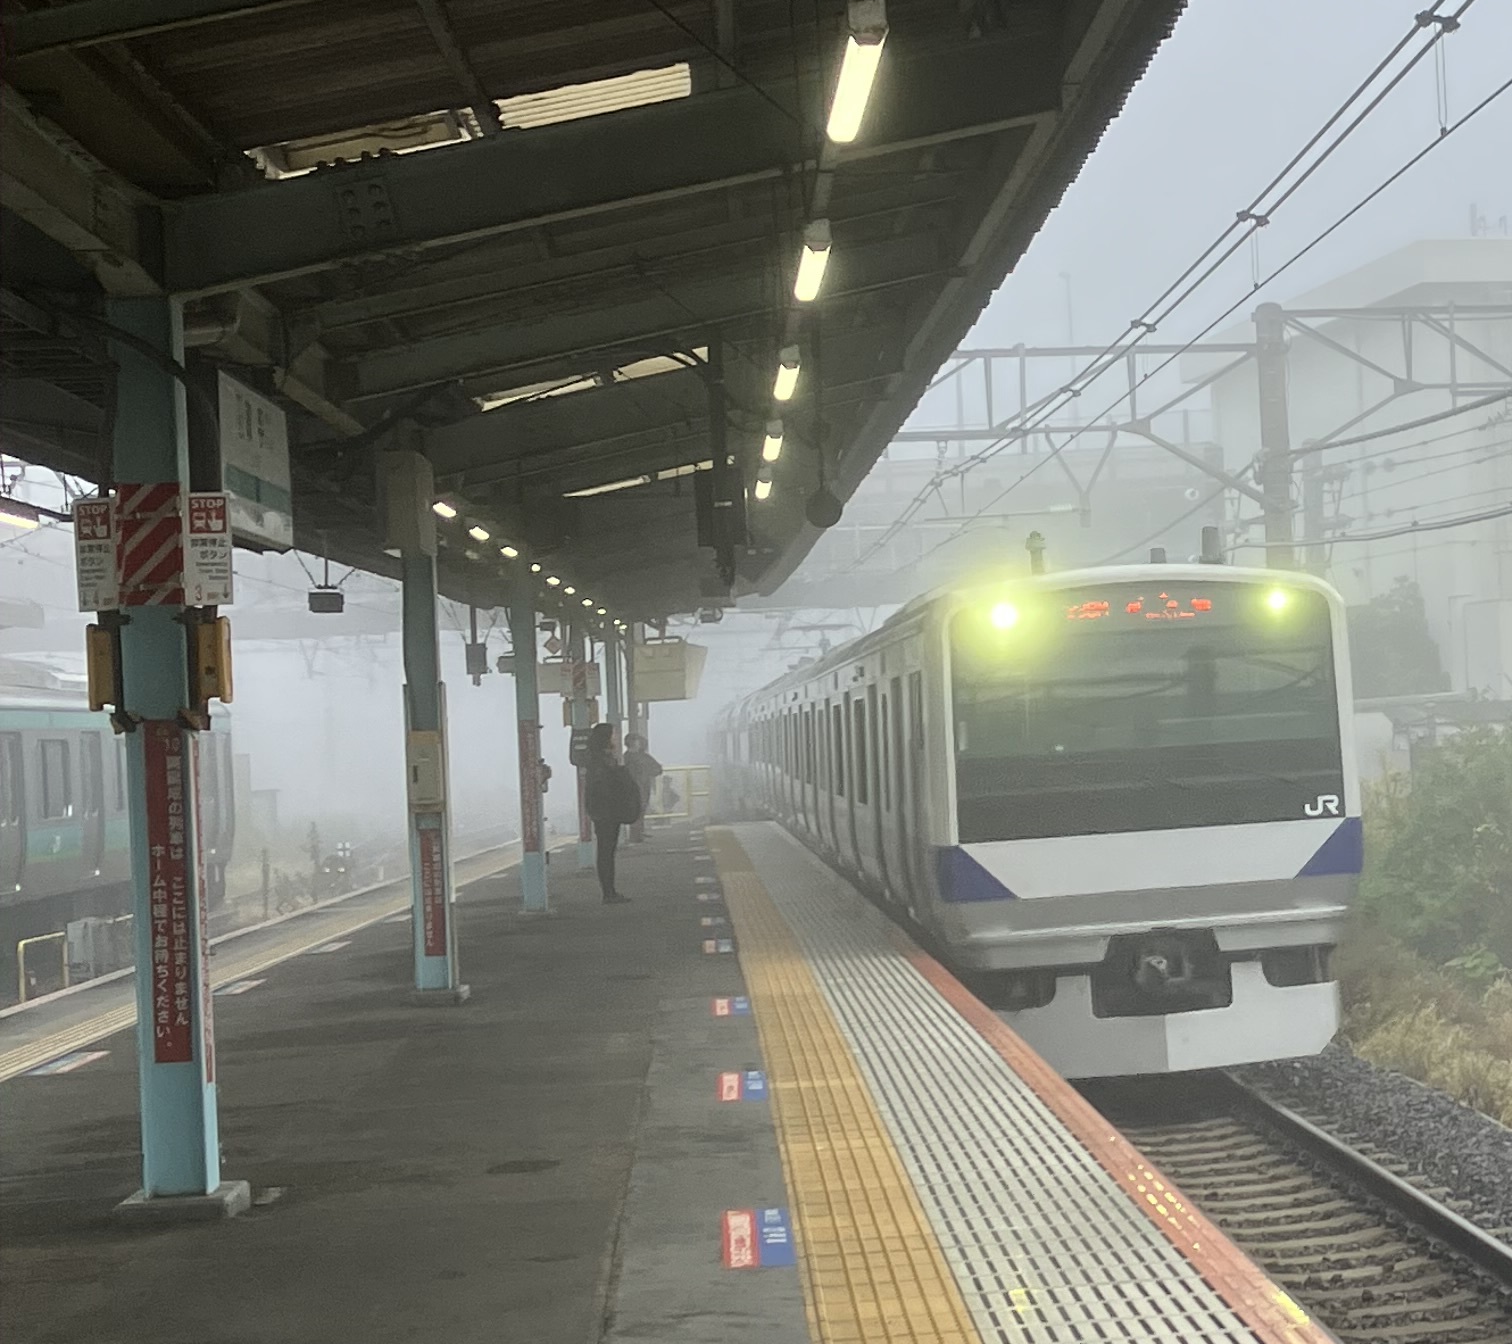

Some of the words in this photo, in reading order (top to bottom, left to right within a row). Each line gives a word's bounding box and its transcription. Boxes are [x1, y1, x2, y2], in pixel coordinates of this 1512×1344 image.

[191, 499, 224, 509] STOP
[78, 505, 108, 516] STOP
[1304, 794, 1339, 816] JR
